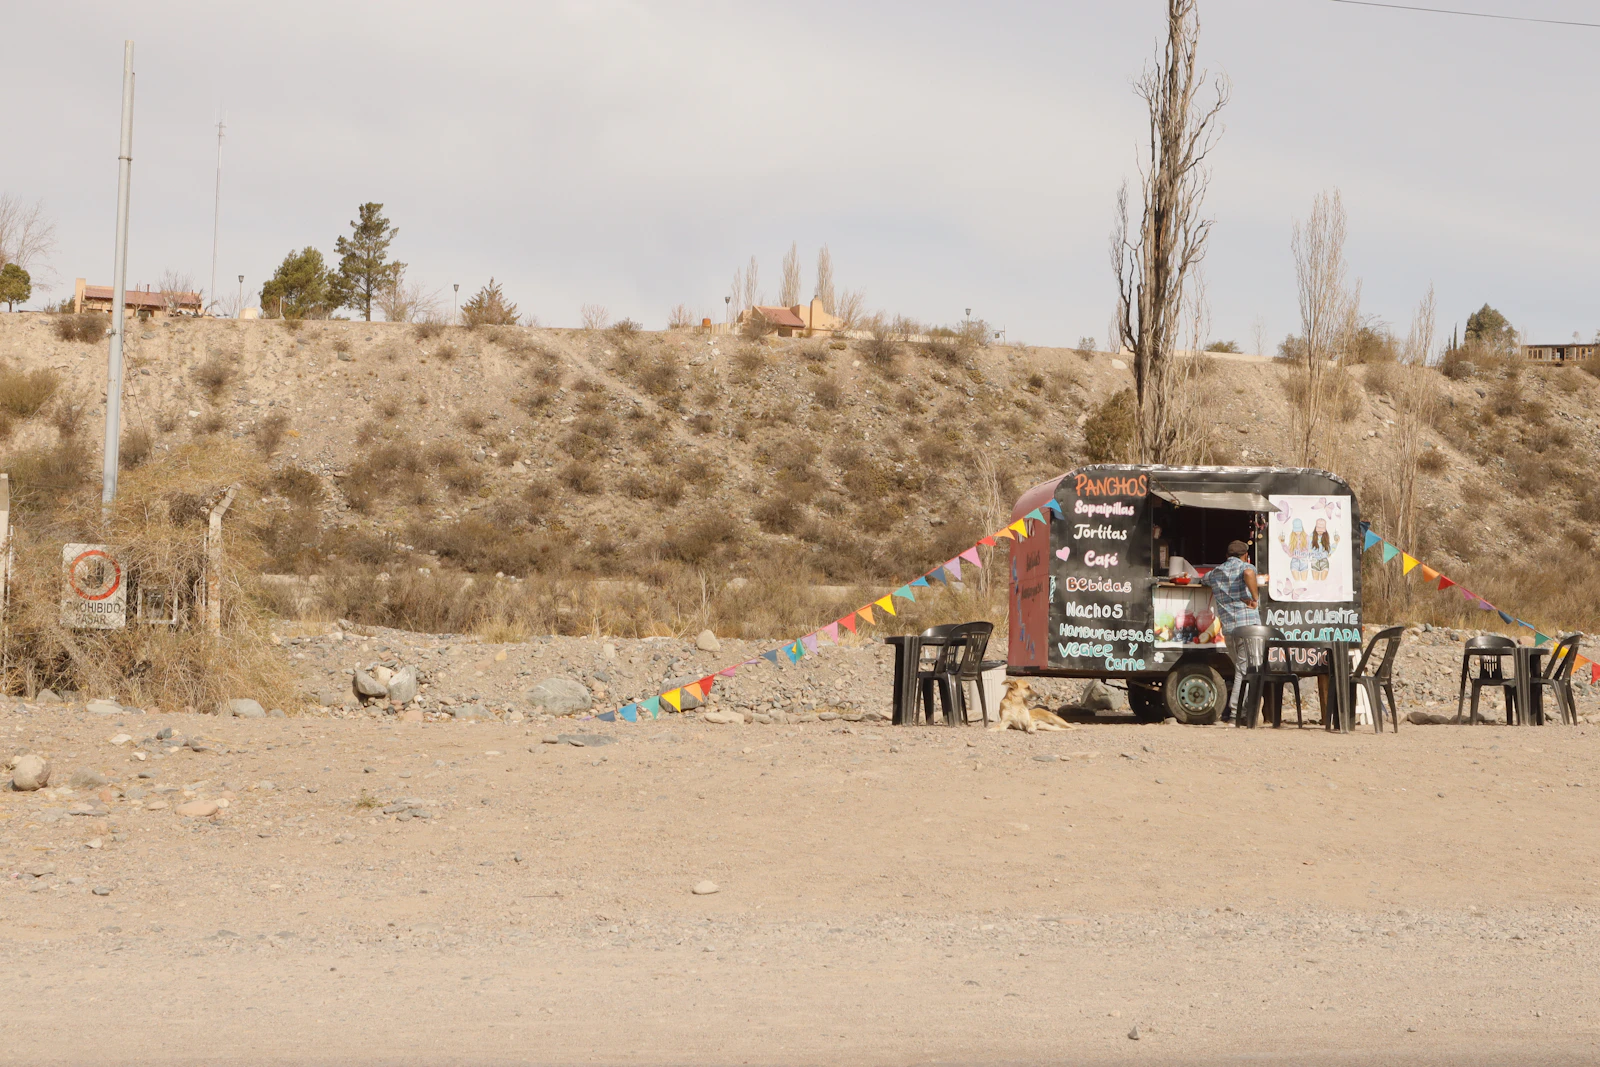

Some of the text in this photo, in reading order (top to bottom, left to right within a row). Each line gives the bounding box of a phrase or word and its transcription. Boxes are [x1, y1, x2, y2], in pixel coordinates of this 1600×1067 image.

[1074, 473, 1149, 497] PANCHOS
[1074, 499, 1135, 518] Sopaipillas
[1073, 523, 1128, 541] Tortitas
[1084, 550, 1119, 566] Café
[1066, 576, 1132, 593] Bebidas
[1066, 601, 1124, 619] Nachos
[1265, 608, 1303, 626] AGUA
[1269, 627, 1362, 642] OCOLATADA
[1105, 657, 1146, 672] Carne
